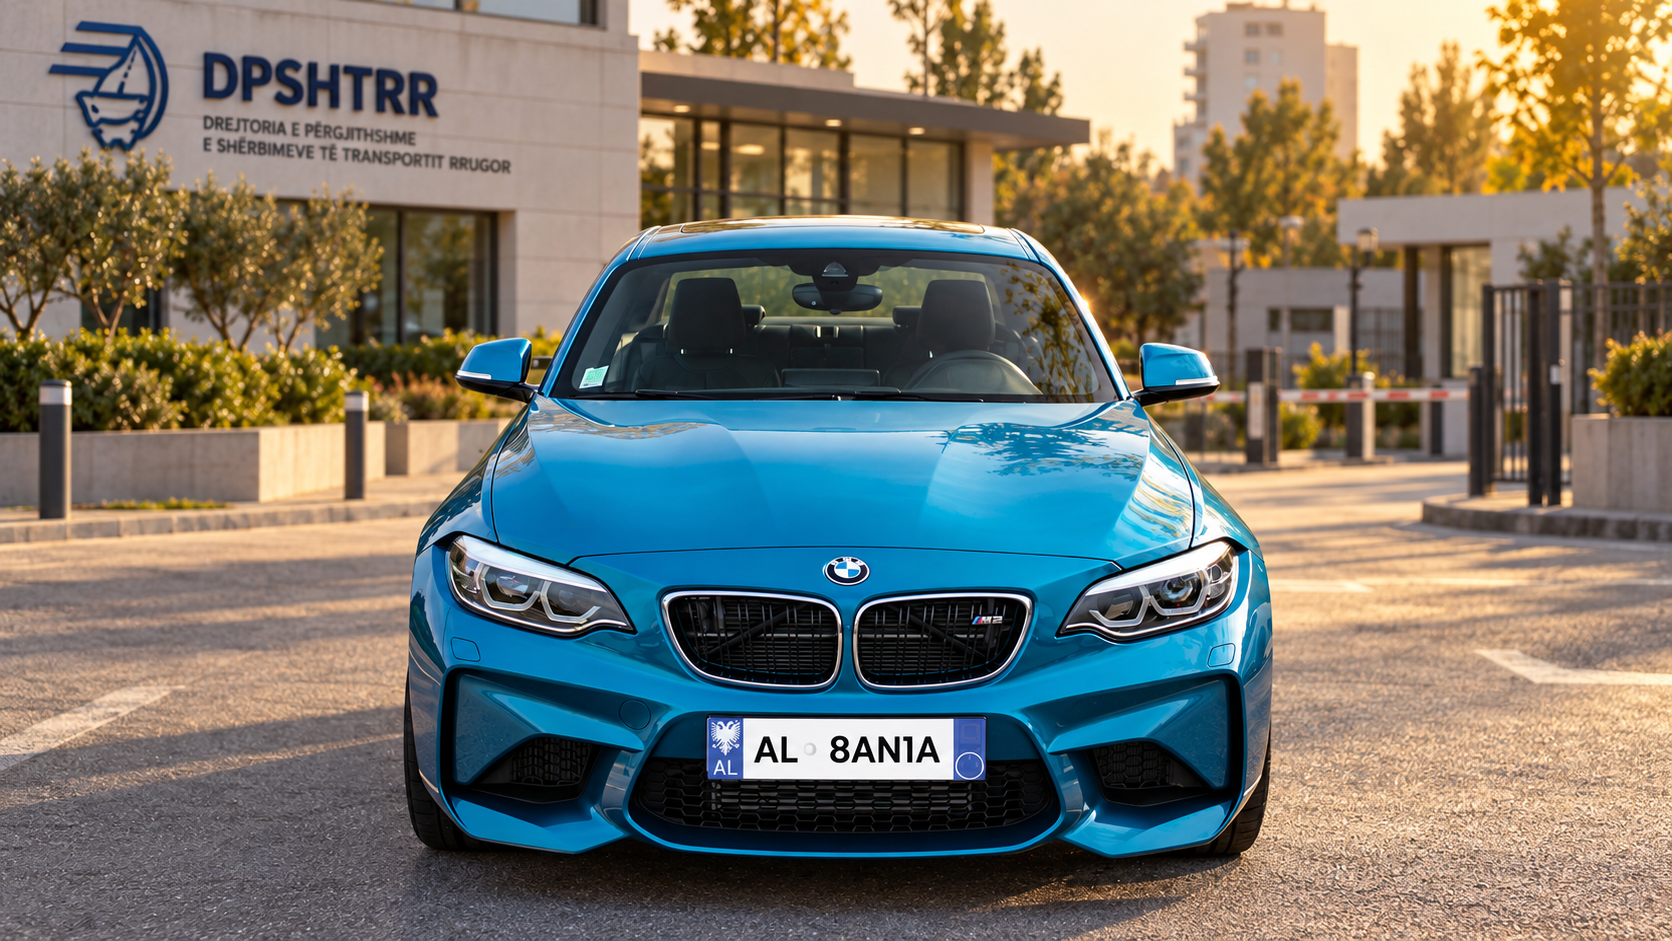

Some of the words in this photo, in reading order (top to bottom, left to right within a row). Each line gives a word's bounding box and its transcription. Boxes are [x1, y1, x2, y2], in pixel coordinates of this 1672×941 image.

[203, 52, 439, 118] DPSHTRR
[203, 115, 287, 136] DREJTORIA
[291, 122, 301, 137] E
[304, 121, 417, 146] PËRGJITHSHME
[203, 137, 212, 152] E
[217, 136, 315, 160] SHËRBIMEVE
[319, 143, 338, 161] TË
[342, 147, 445, 169] TRANSPORTIT
[449, 156, 512, 174] RRUGOR
[979, 615, 1003, 625] M2
[753, 735, 798, 764] AL
[829, 735, 941, 764] 8AN1A
[713, 759, 738, 776] AL
